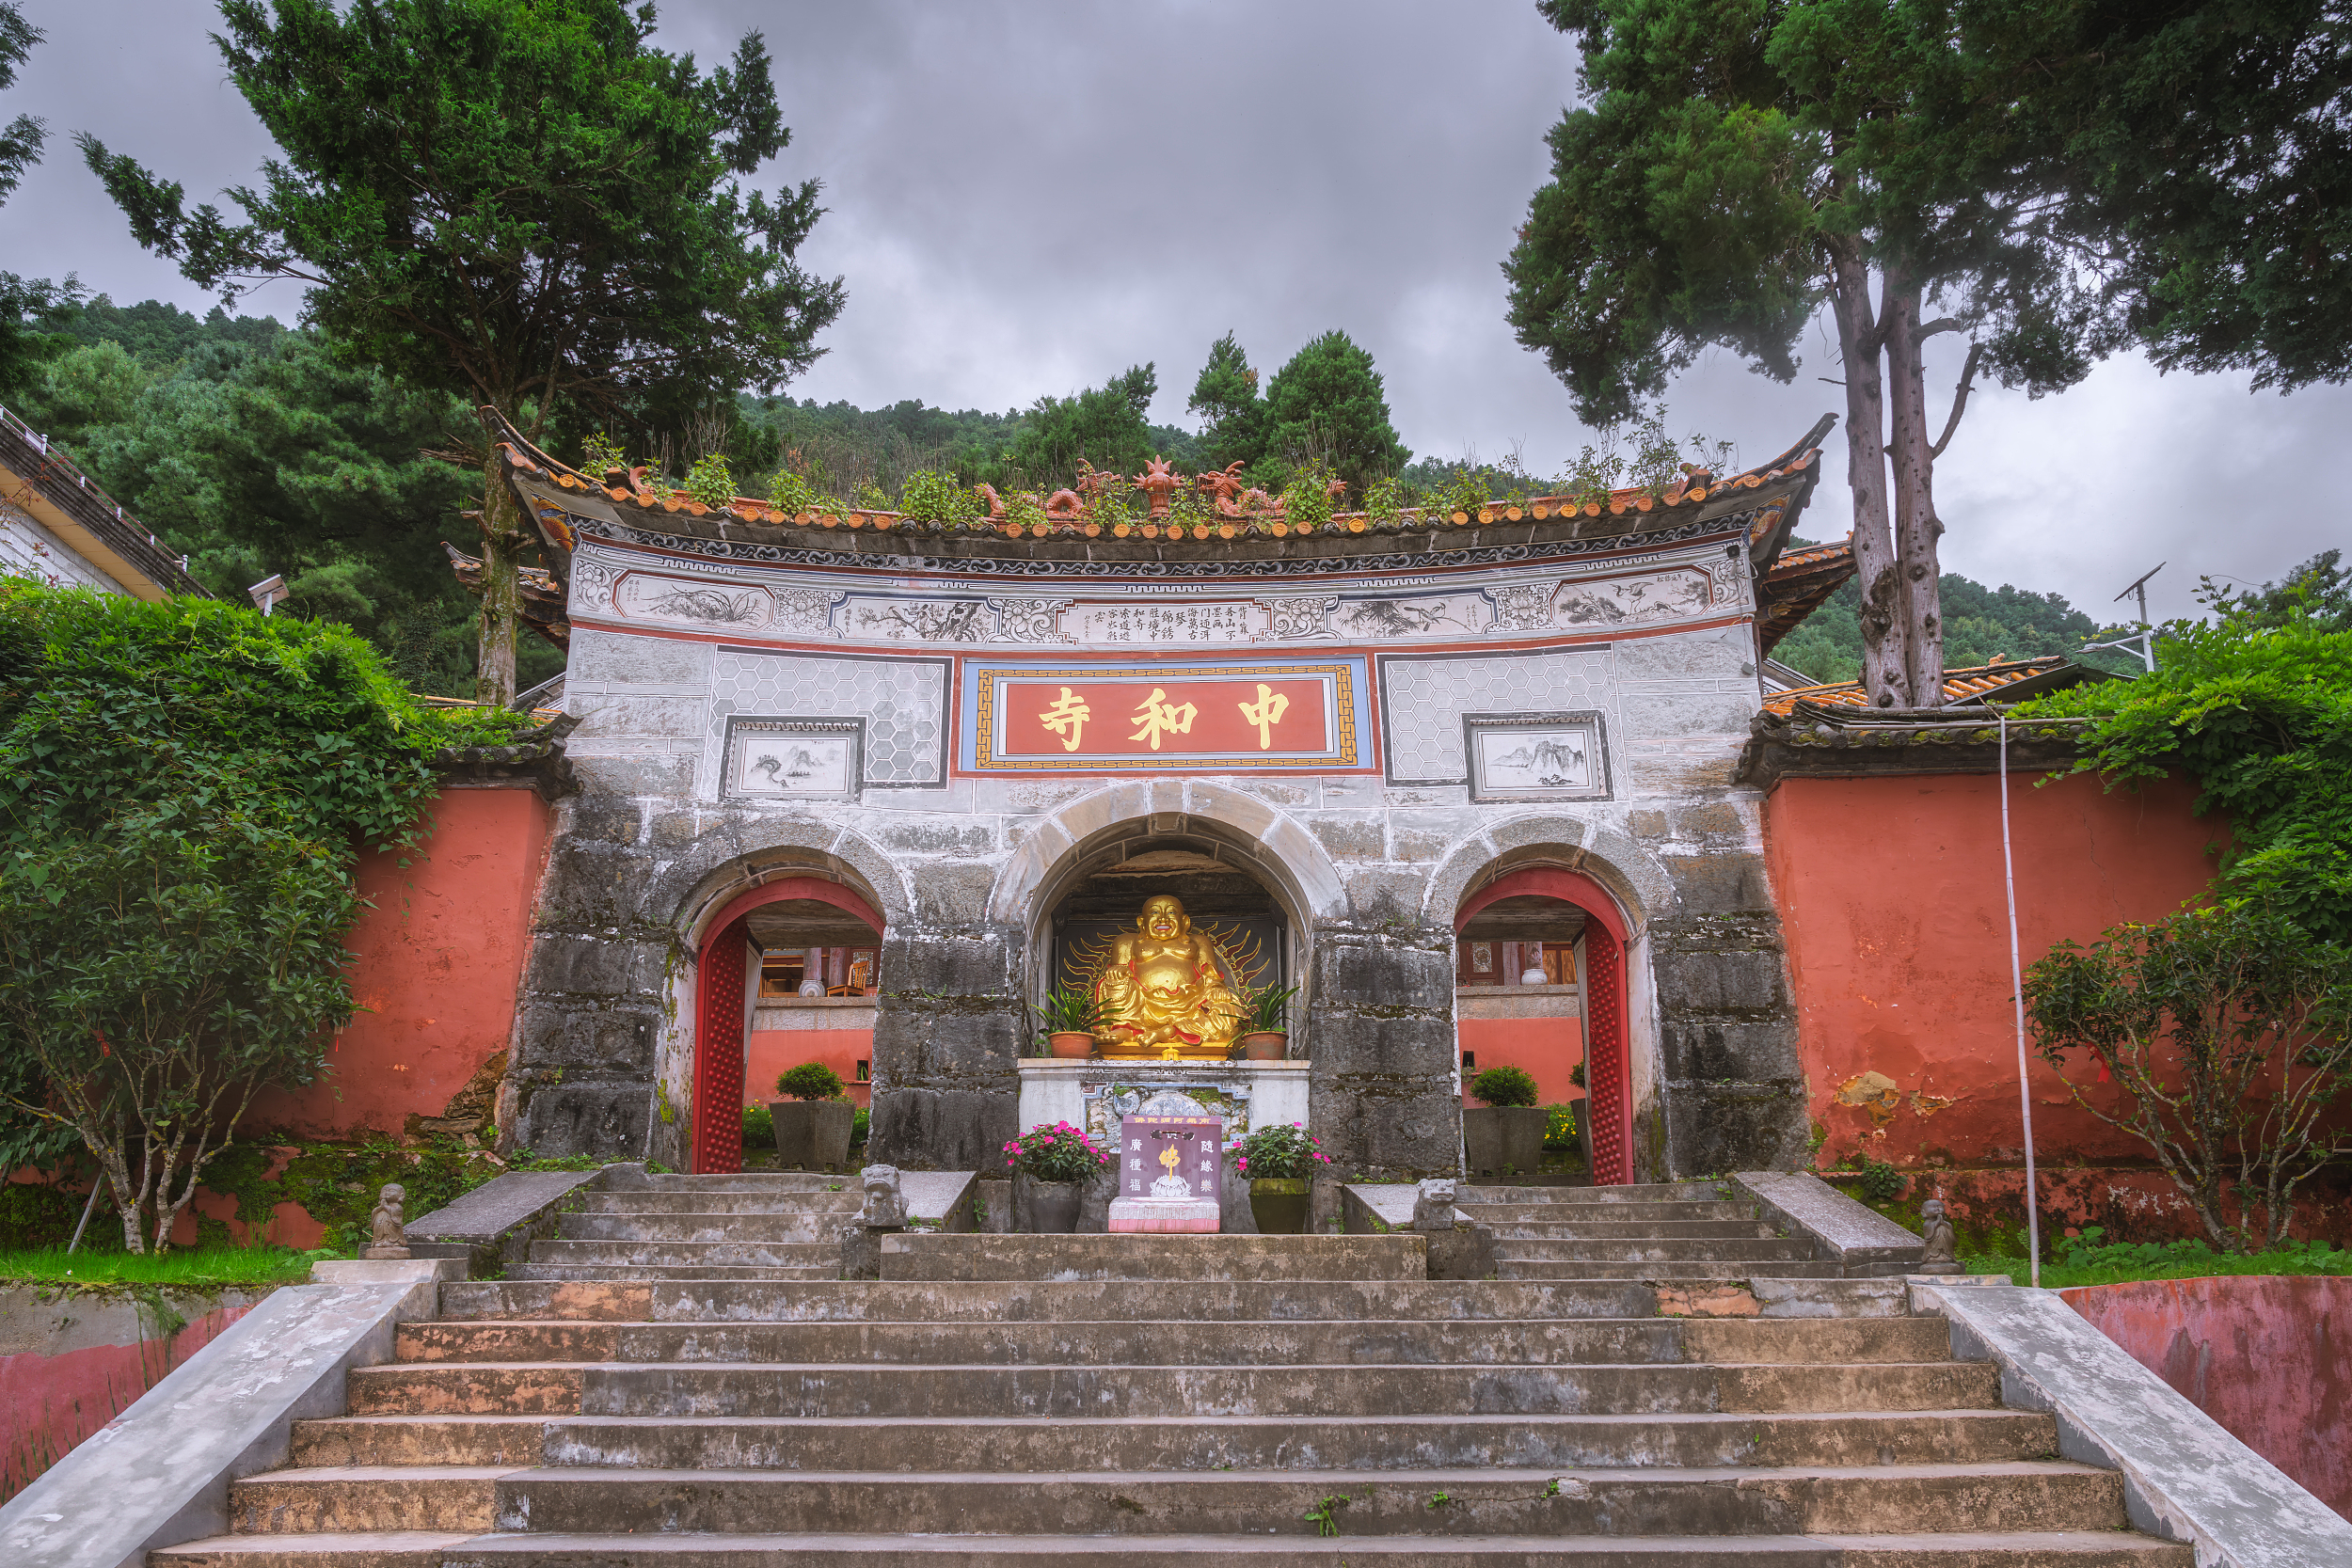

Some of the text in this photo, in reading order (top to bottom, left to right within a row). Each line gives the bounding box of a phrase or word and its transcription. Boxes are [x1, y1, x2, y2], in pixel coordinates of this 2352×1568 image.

[1175, 611, 1187, 627] 琴
[1039, 683, 1290, 752] 中和寺
[1129, 1138, 1143, 1192] 廣種福
[1158, 1143, 1181, 1181] 佛
[1200, 1139, 1214, 1193] 隨緣樂
